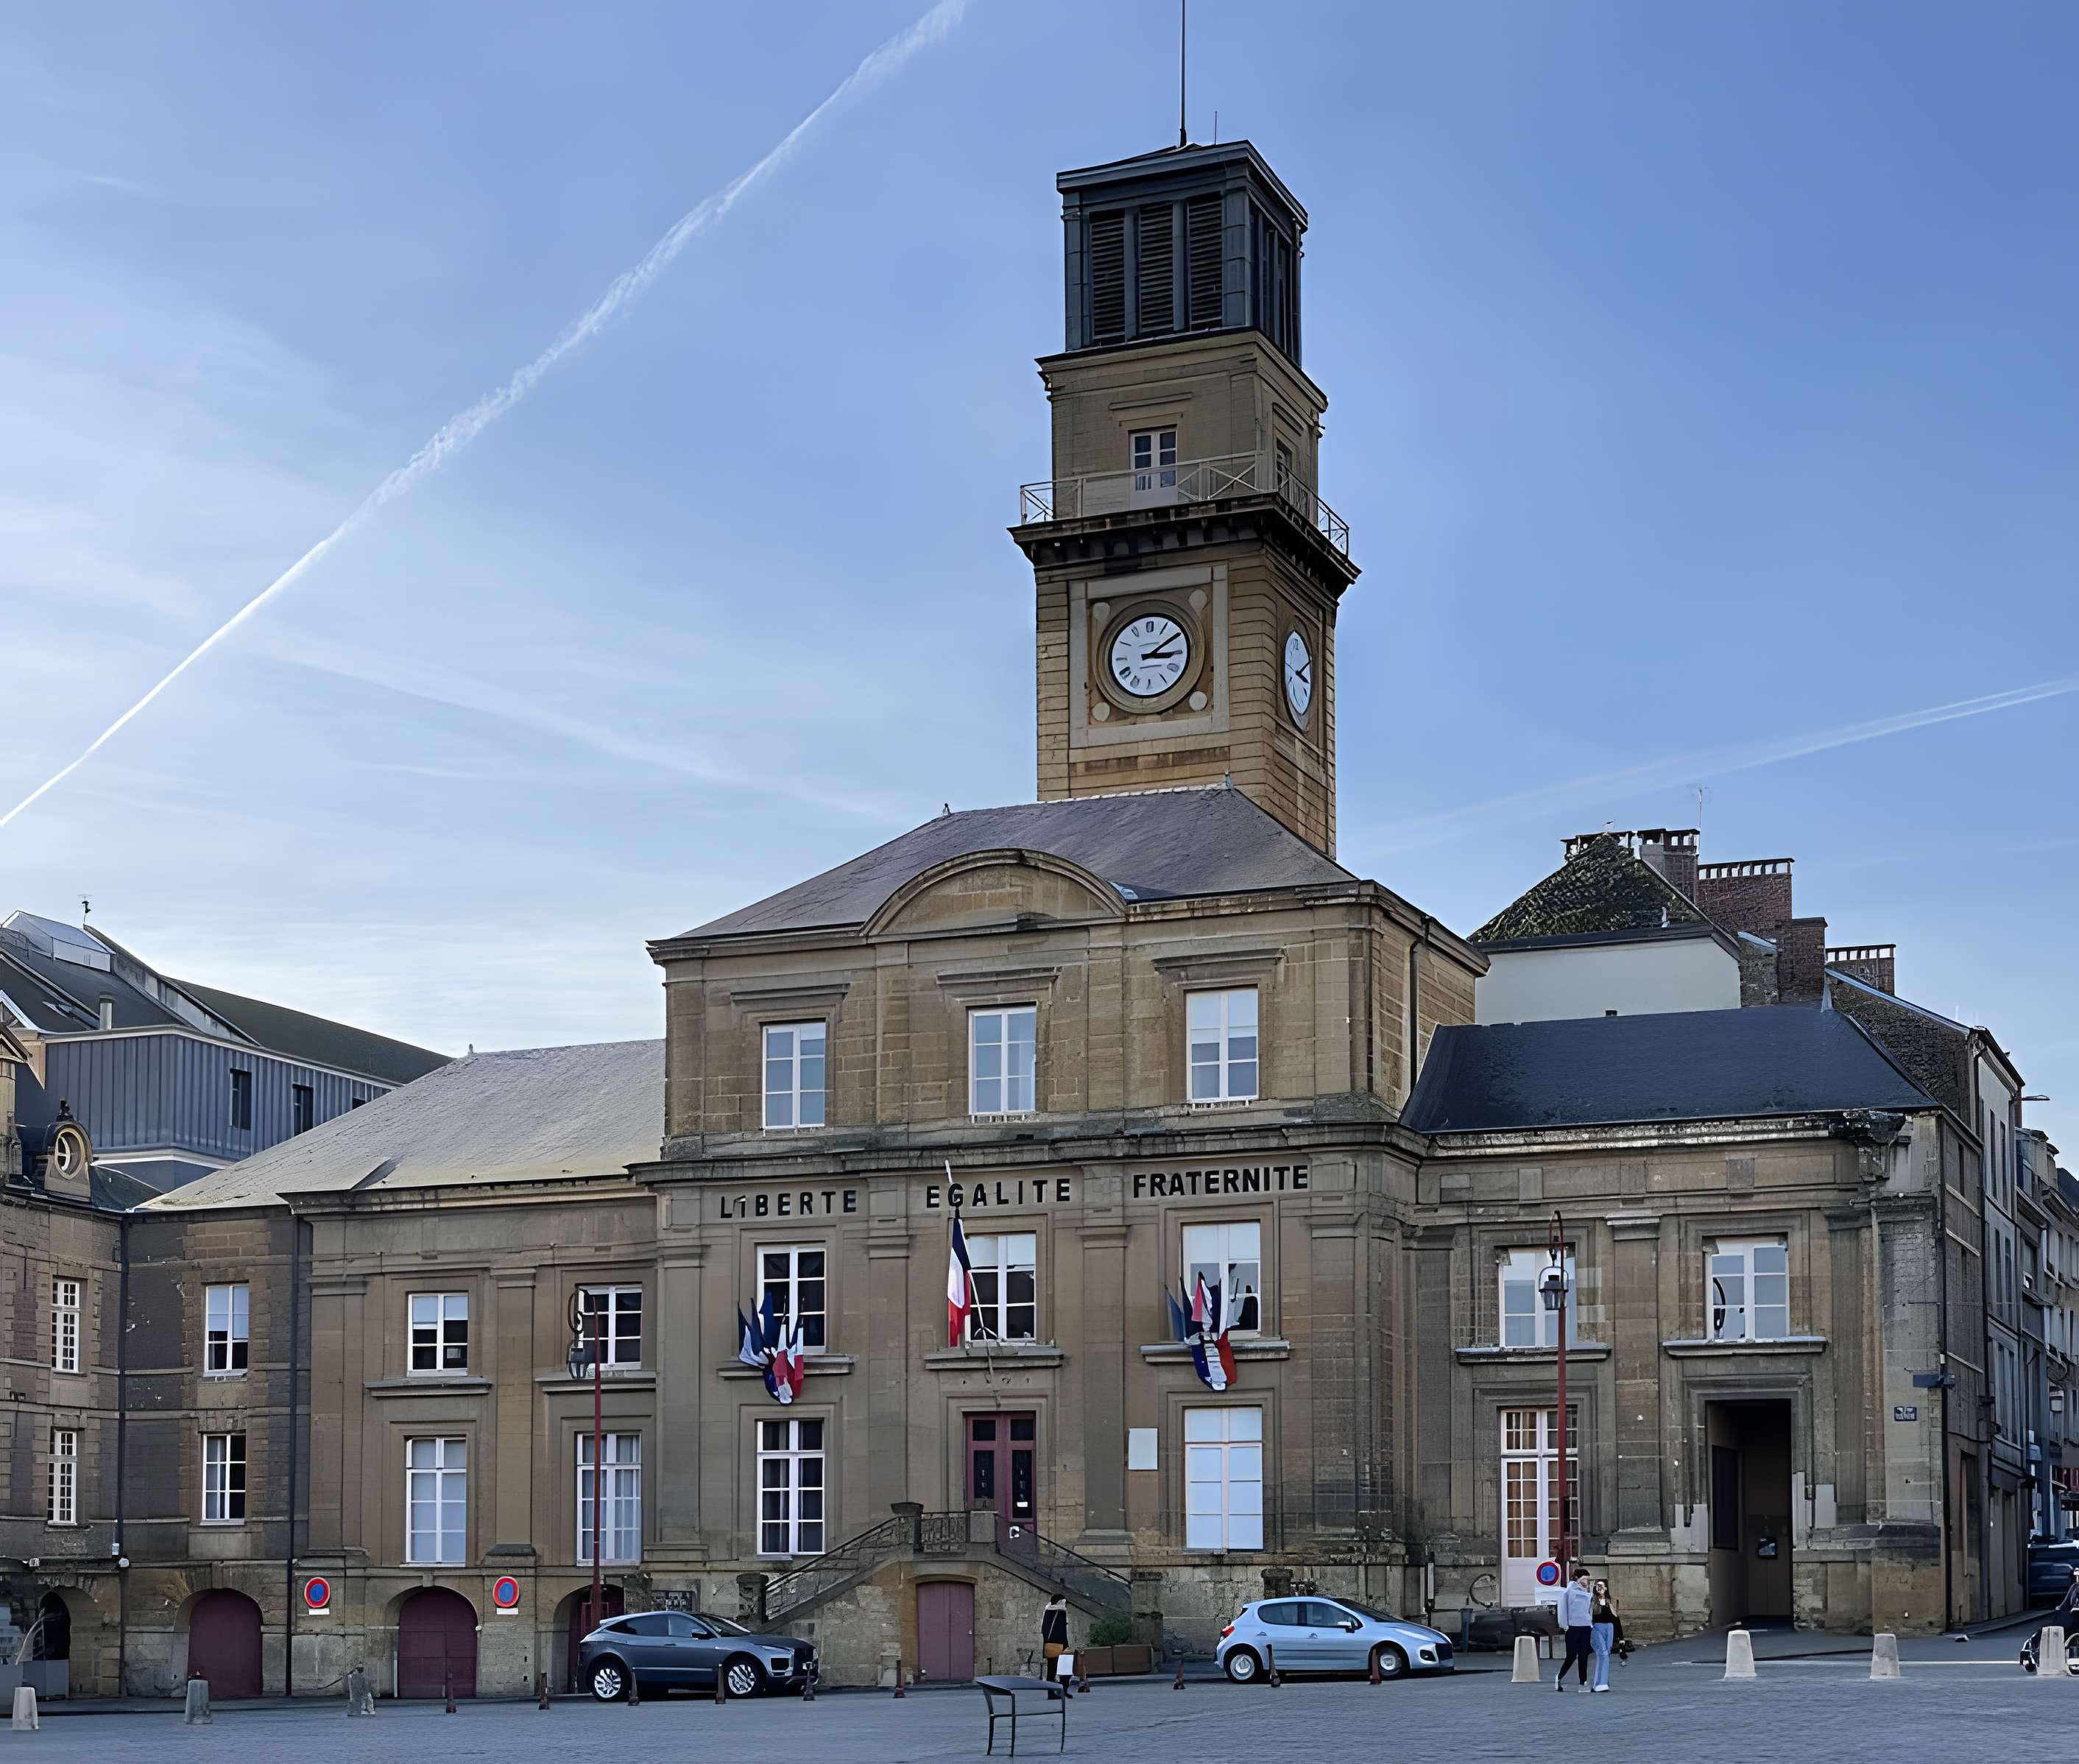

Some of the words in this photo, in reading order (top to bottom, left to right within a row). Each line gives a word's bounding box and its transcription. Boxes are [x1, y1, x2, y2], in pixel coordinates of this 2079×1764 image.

[720, 1190, 857, 1218] LIBERTE
[926, 1178, 1070, 1208] EGALITE
[1133, 1165, 1308, 1199] FRATERNITE
